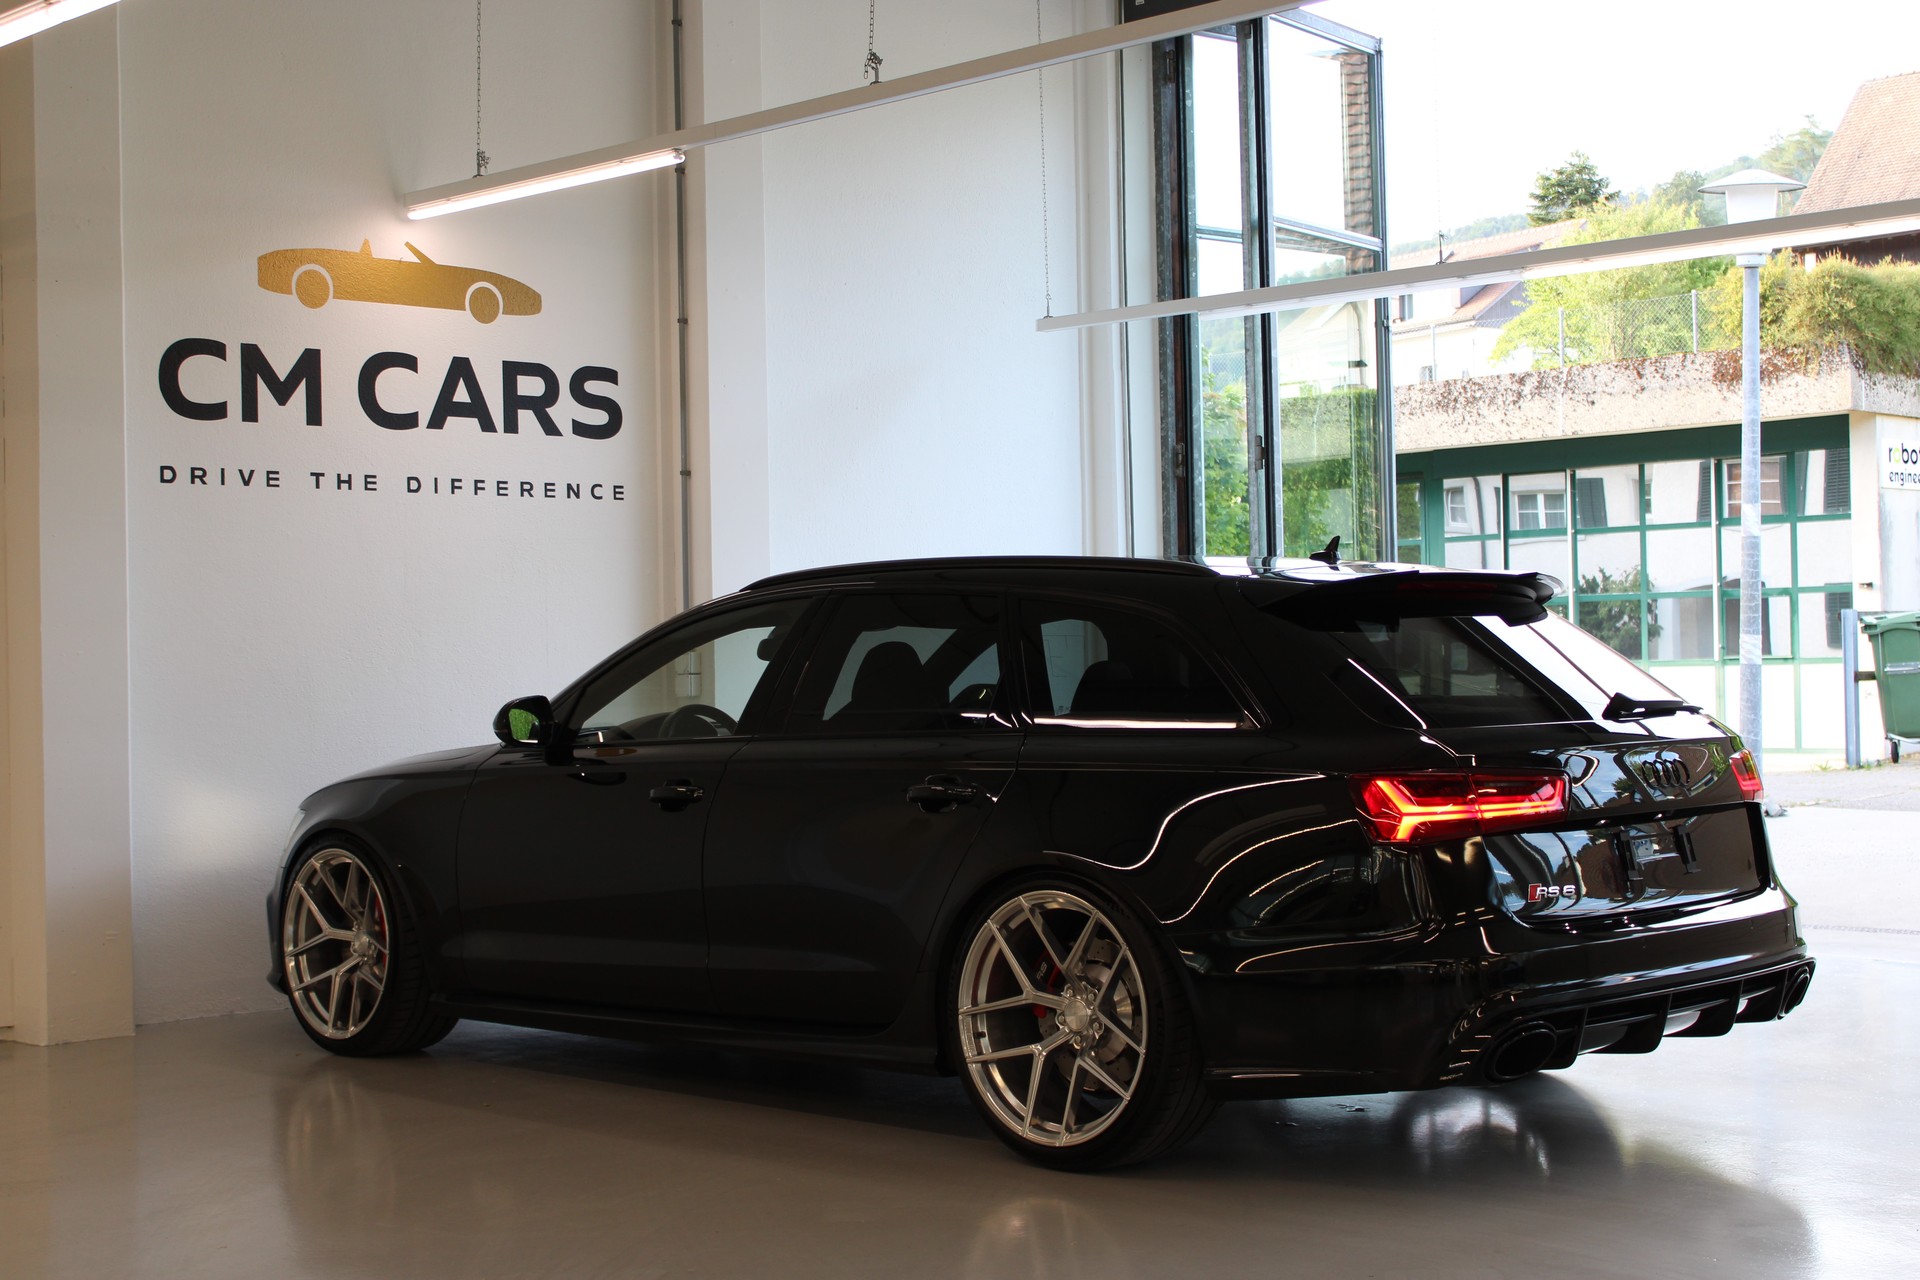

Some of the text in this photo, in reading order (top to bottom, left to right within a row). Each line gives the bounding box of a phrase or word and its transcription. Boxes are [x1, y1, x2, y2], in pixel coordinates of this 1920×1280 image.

[158, 337, 623, 440] CM CARS
[1888, 442, 1920, 465] robo
[159, 465, 625, 501] DRIVE THE DIFFERENCE
